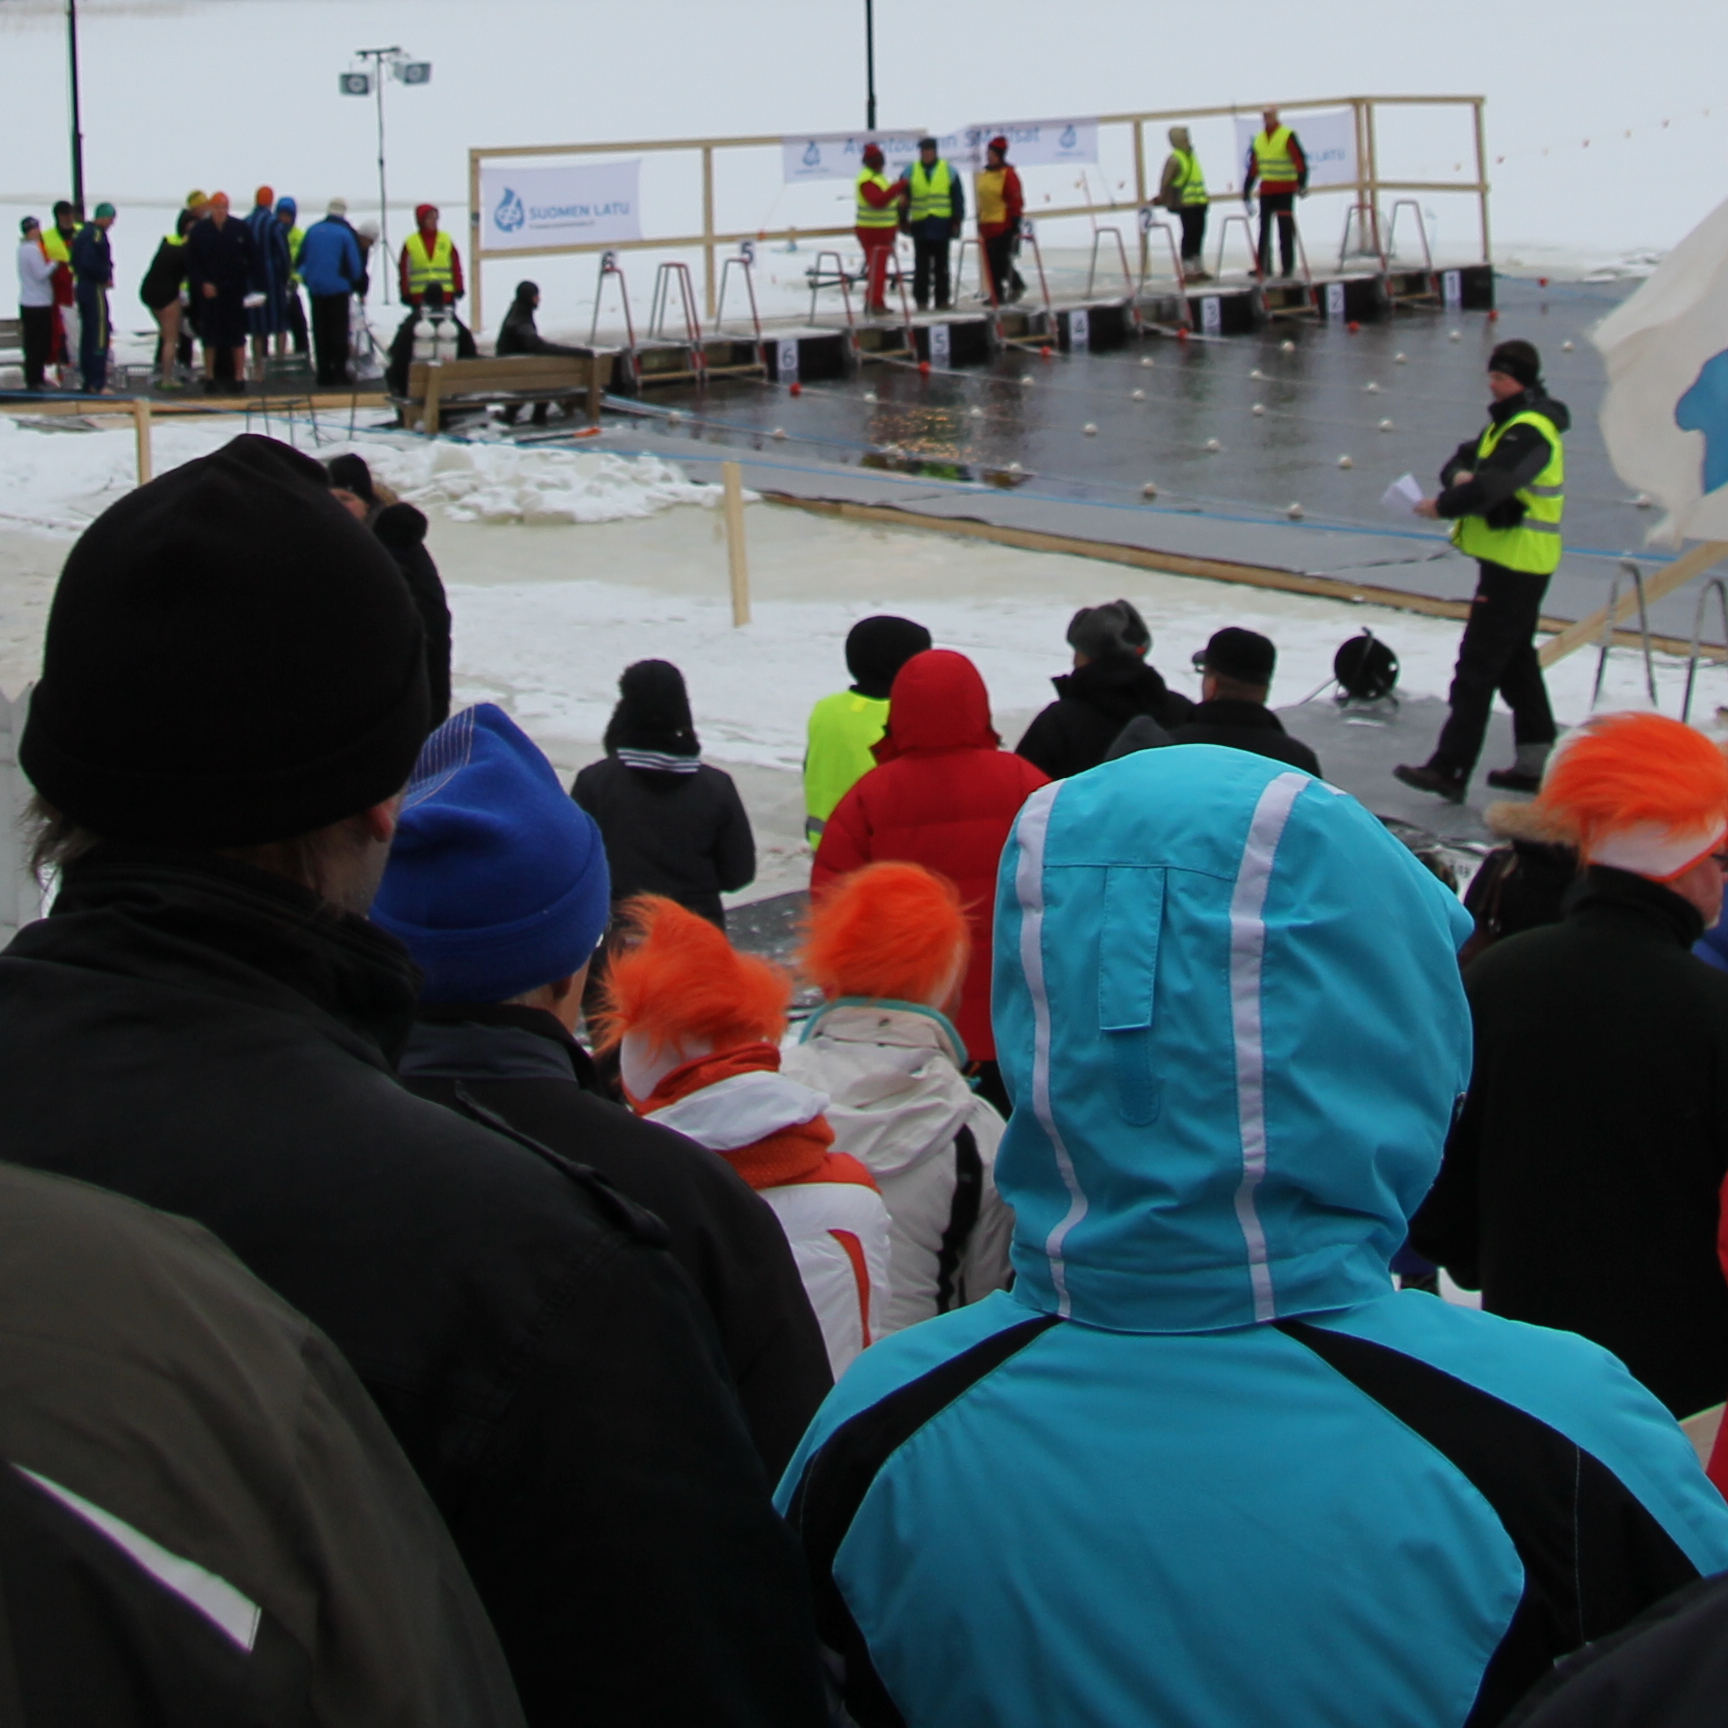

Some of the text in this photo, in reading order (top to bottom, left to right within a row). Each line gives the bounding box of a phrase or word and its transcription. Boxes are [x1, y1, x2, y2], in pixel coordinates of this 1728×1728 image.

[529, 202, 629, 220] SUOMEN LATU
[741, 241, 753, 263] 5
[1330, 286, 1343, 311] 2
[1206, 300, 1218, 324] 3
[935, 331, 946, 352] 5
[782, 348, 796, 369] 6
